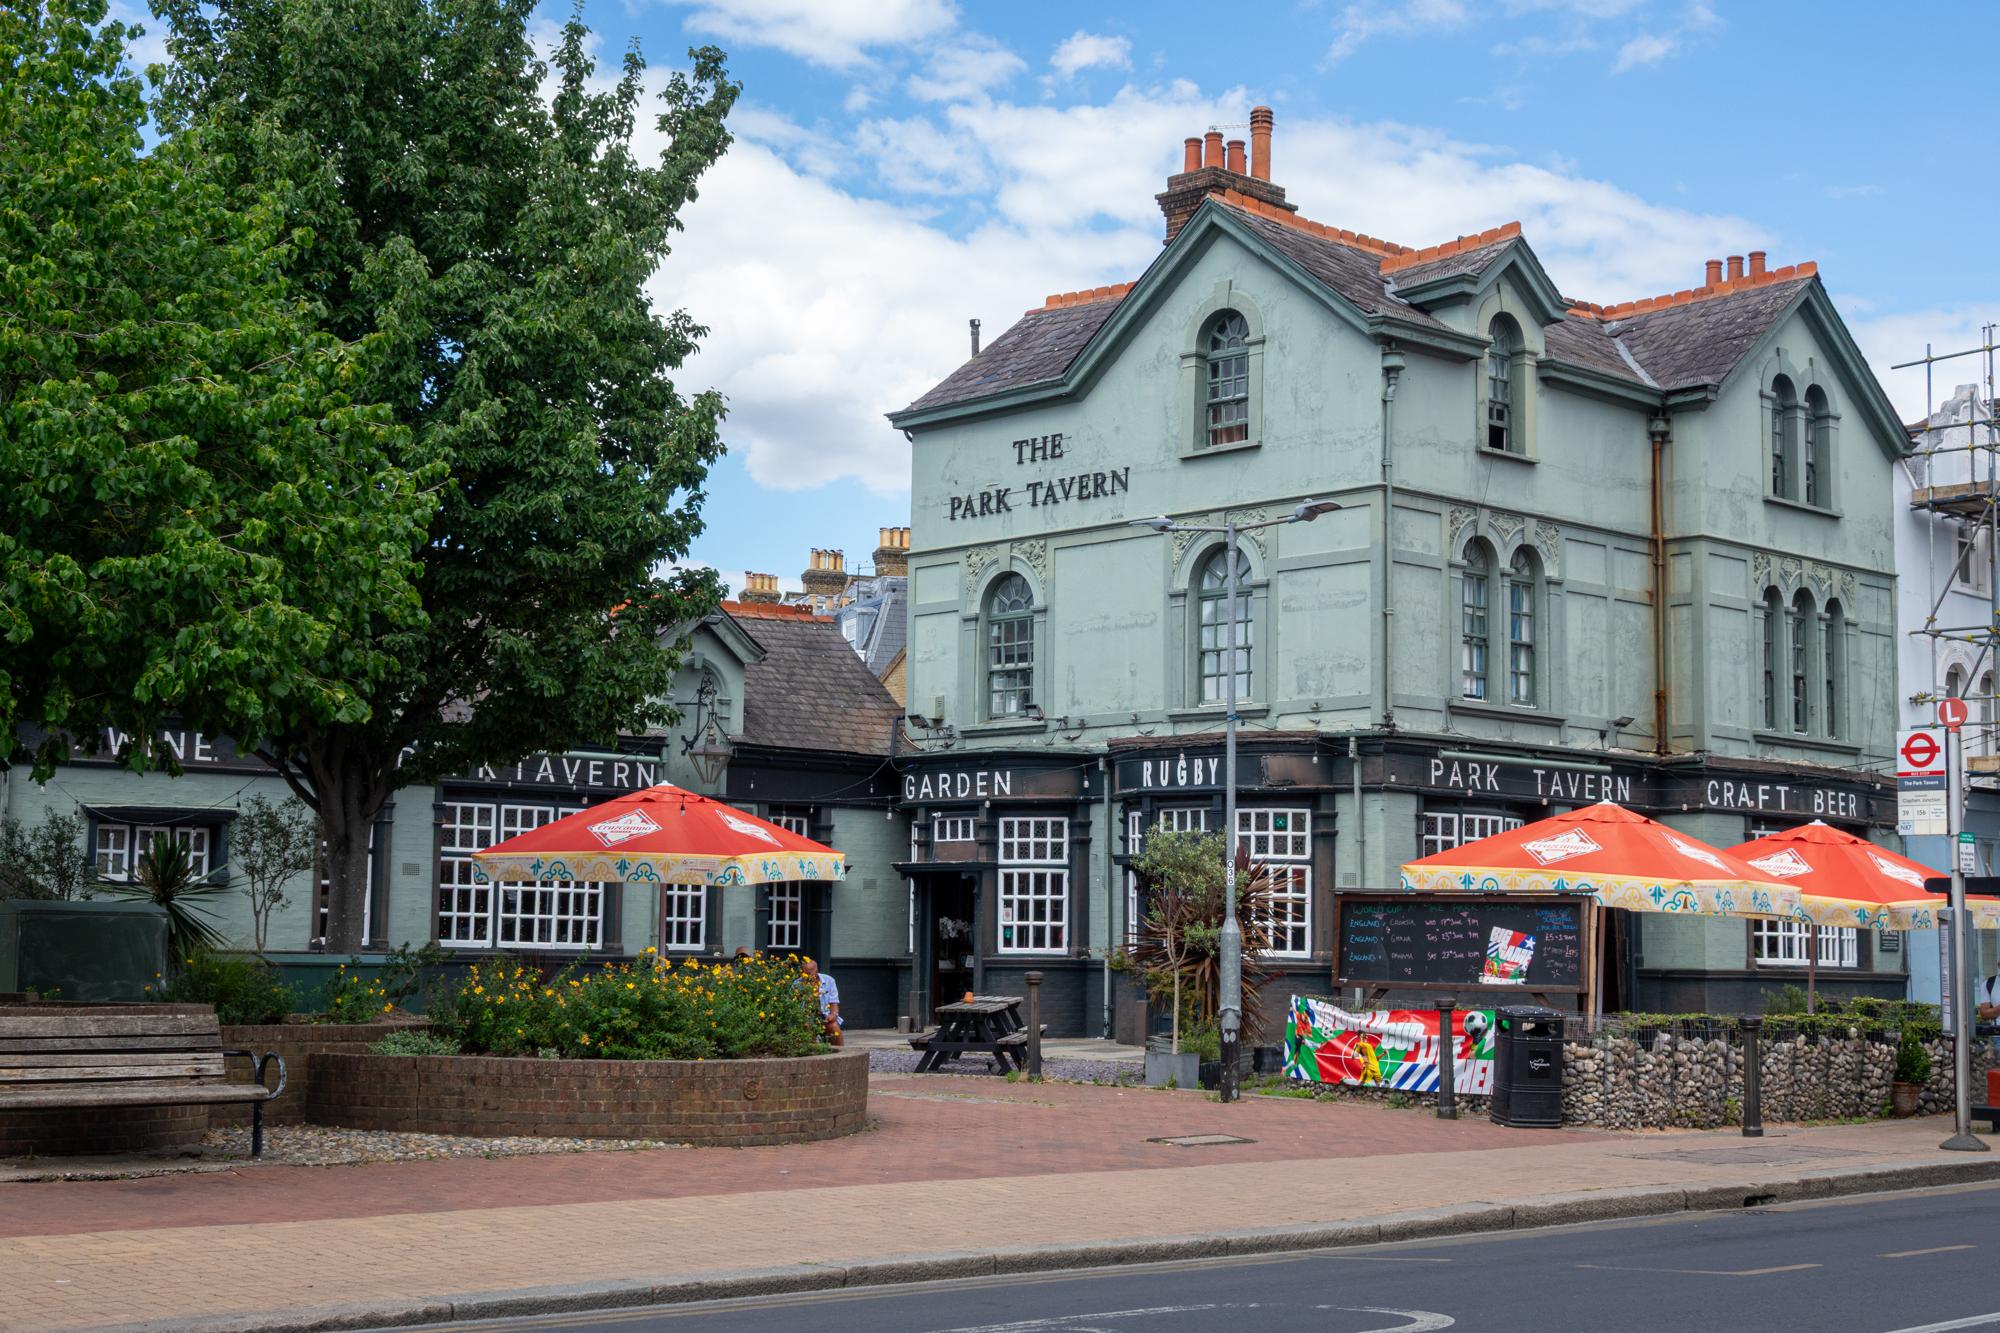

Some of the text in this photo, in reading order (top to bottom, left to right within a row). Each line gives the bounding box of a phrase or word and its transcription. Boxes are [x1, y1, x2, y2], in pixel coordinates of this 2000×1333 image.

[1013, 433, 1063, 464] THE
[950, 467, 1130, 520] PARK TAVERN
[1946, 702, 1960, 722] L
[905, 771, 1011, 799] GARDEN
[1143, 758, 1218, 787] RUGBY
[1431, 759, 1630, 801] PARK TAVERN
[1707, 780, 1856, 816] CRAFT BEER
[598, 824, 651, 832] Cruzcampo
[1490, 927, 1513, 944] BIG
[1381, 1021, 1425, 1050] CUP
